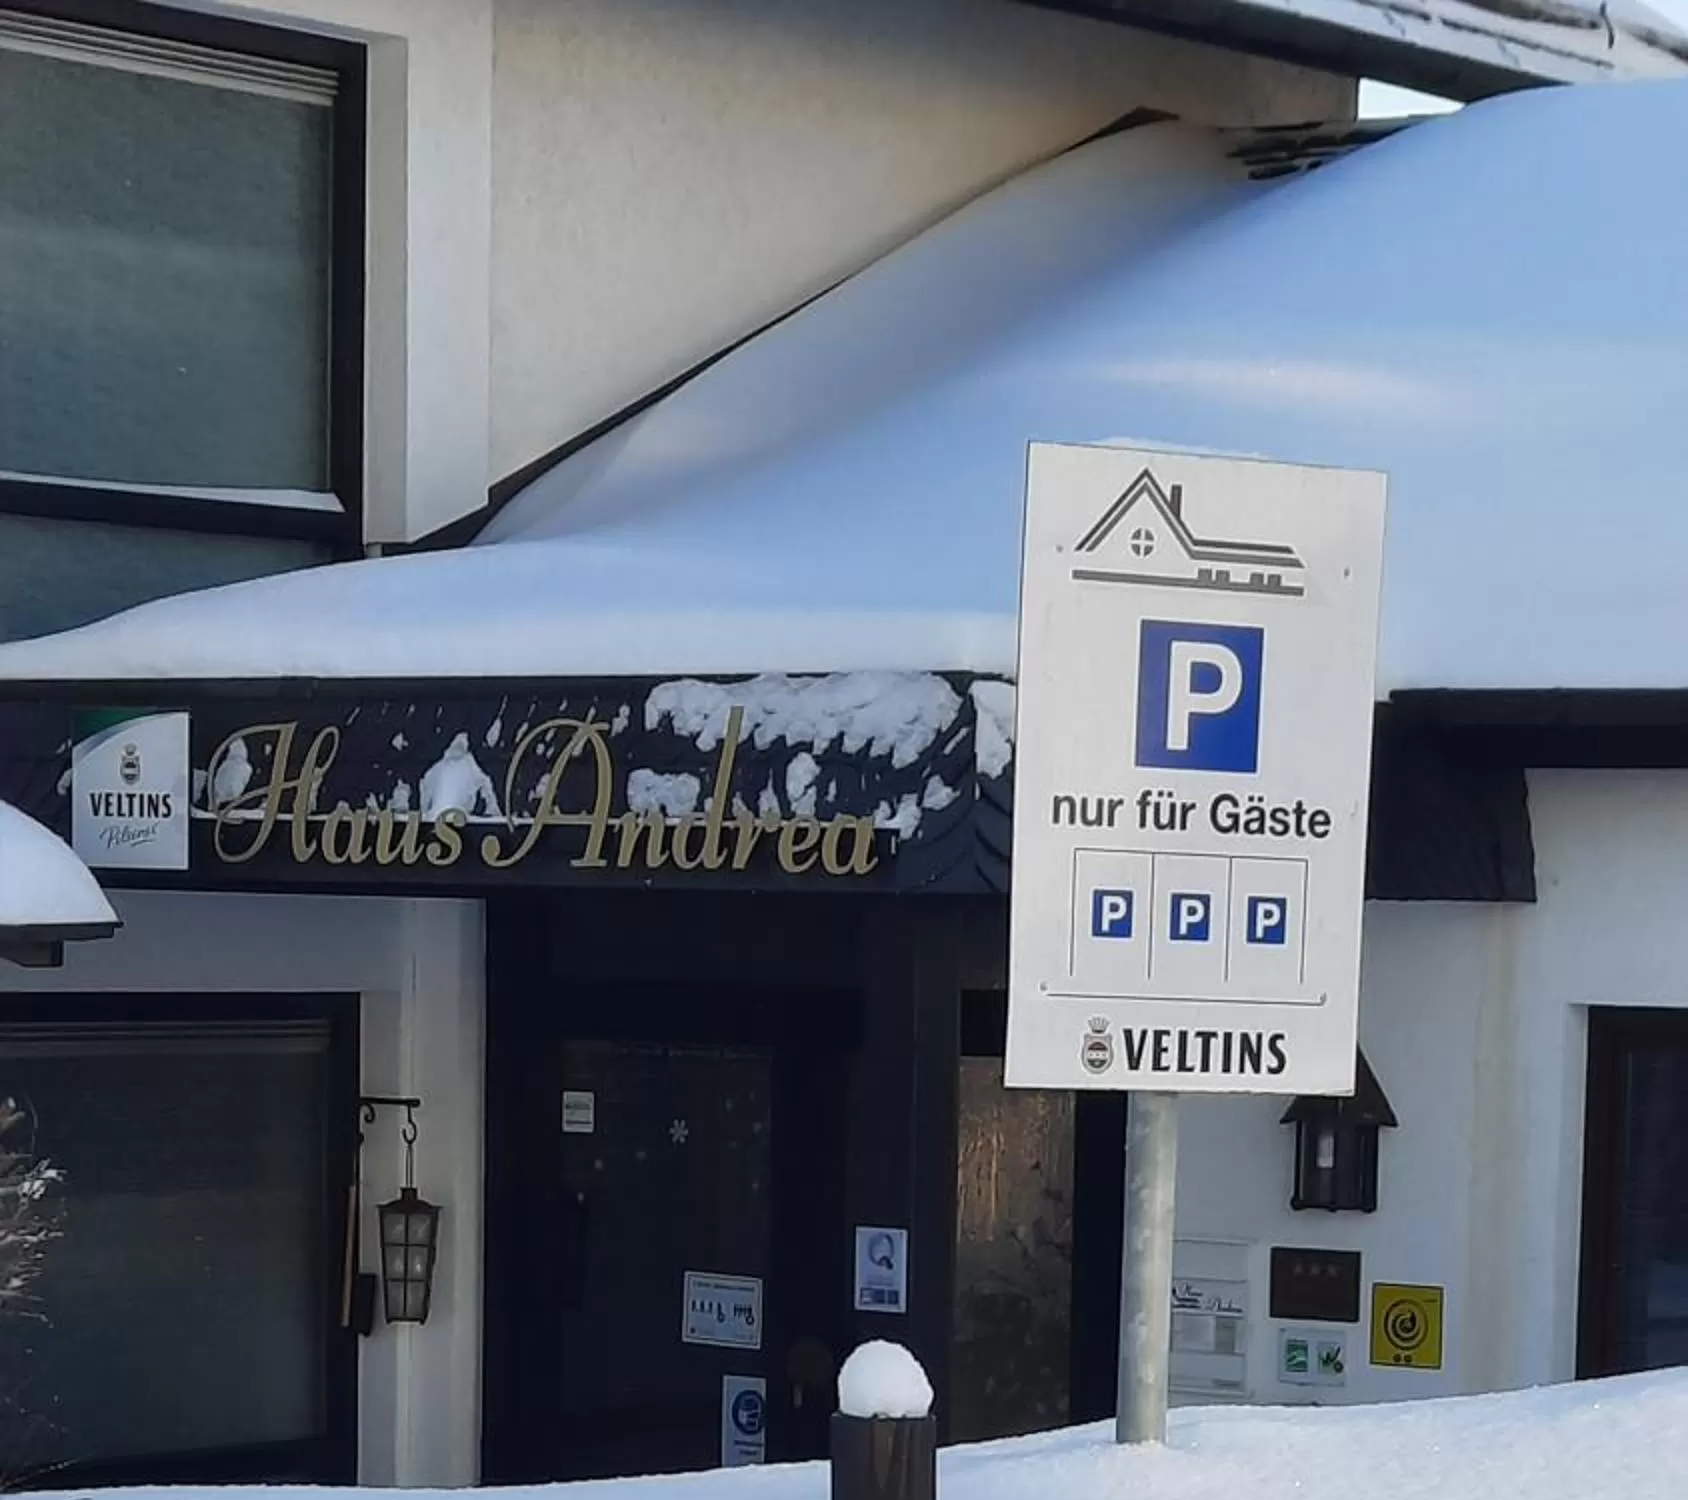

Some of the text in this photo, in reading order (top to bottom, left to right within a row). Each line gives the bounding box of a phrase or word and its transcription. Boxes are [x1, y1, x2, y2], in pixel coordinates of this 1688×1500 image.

[1166, 640, 1243, 751] P
[89, 791, 172, 819] VELTINS
[205, 704, 880, 876] Haus Andrea
[1050, 788, 1333, 840] nur für Gäste
[1101, 897, 1128, 934] P
[1178, 900, 1206, 936] P
[1255, 903, 1282, 938] P
[1123, 1028, 1288, 1076] VELTINS
